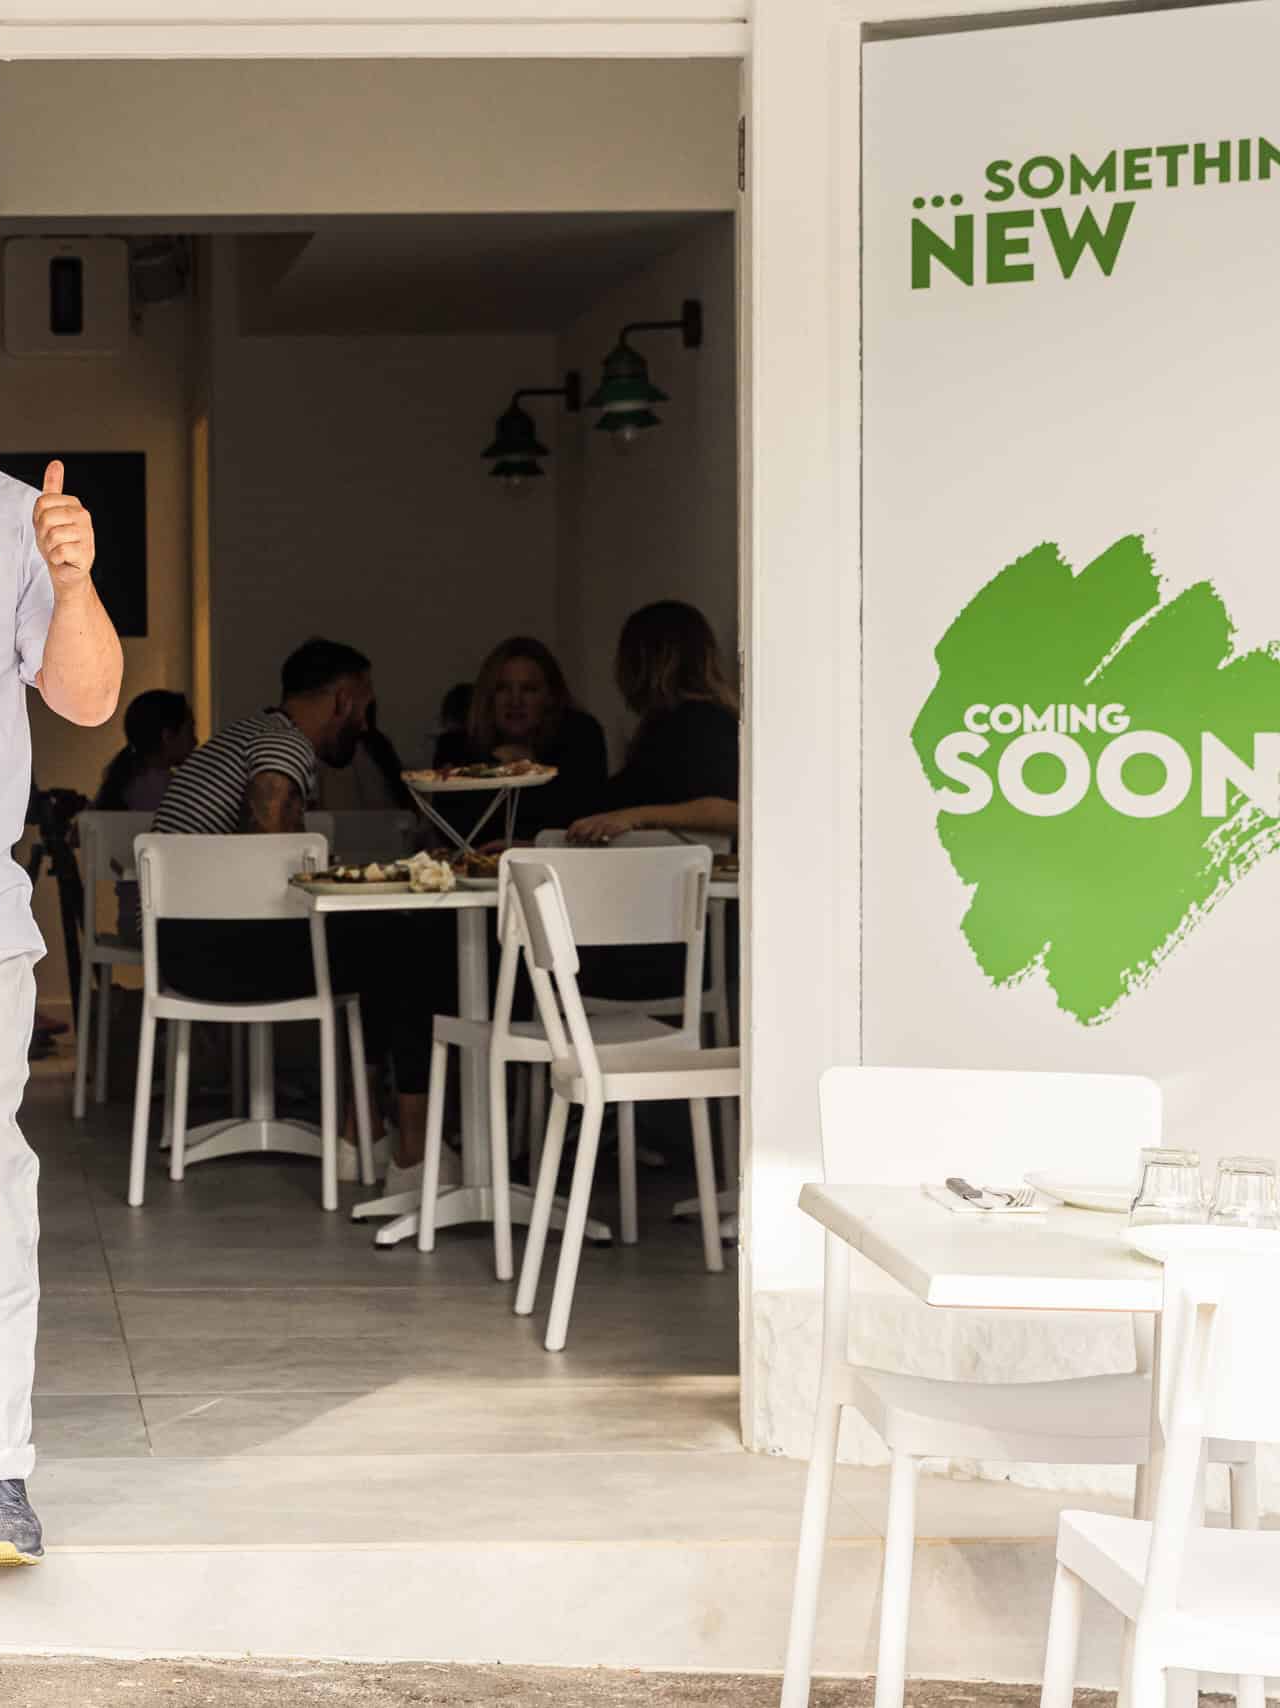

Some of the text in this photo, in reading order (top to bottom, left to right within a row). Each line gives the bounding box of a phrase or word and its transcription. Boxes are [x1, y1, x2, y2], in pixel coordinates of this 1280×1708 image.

[911, 201, 1136, 290] NEW
[963, 703, 1131, 734] COMING
[933, 729, 1280, 819] SOON
